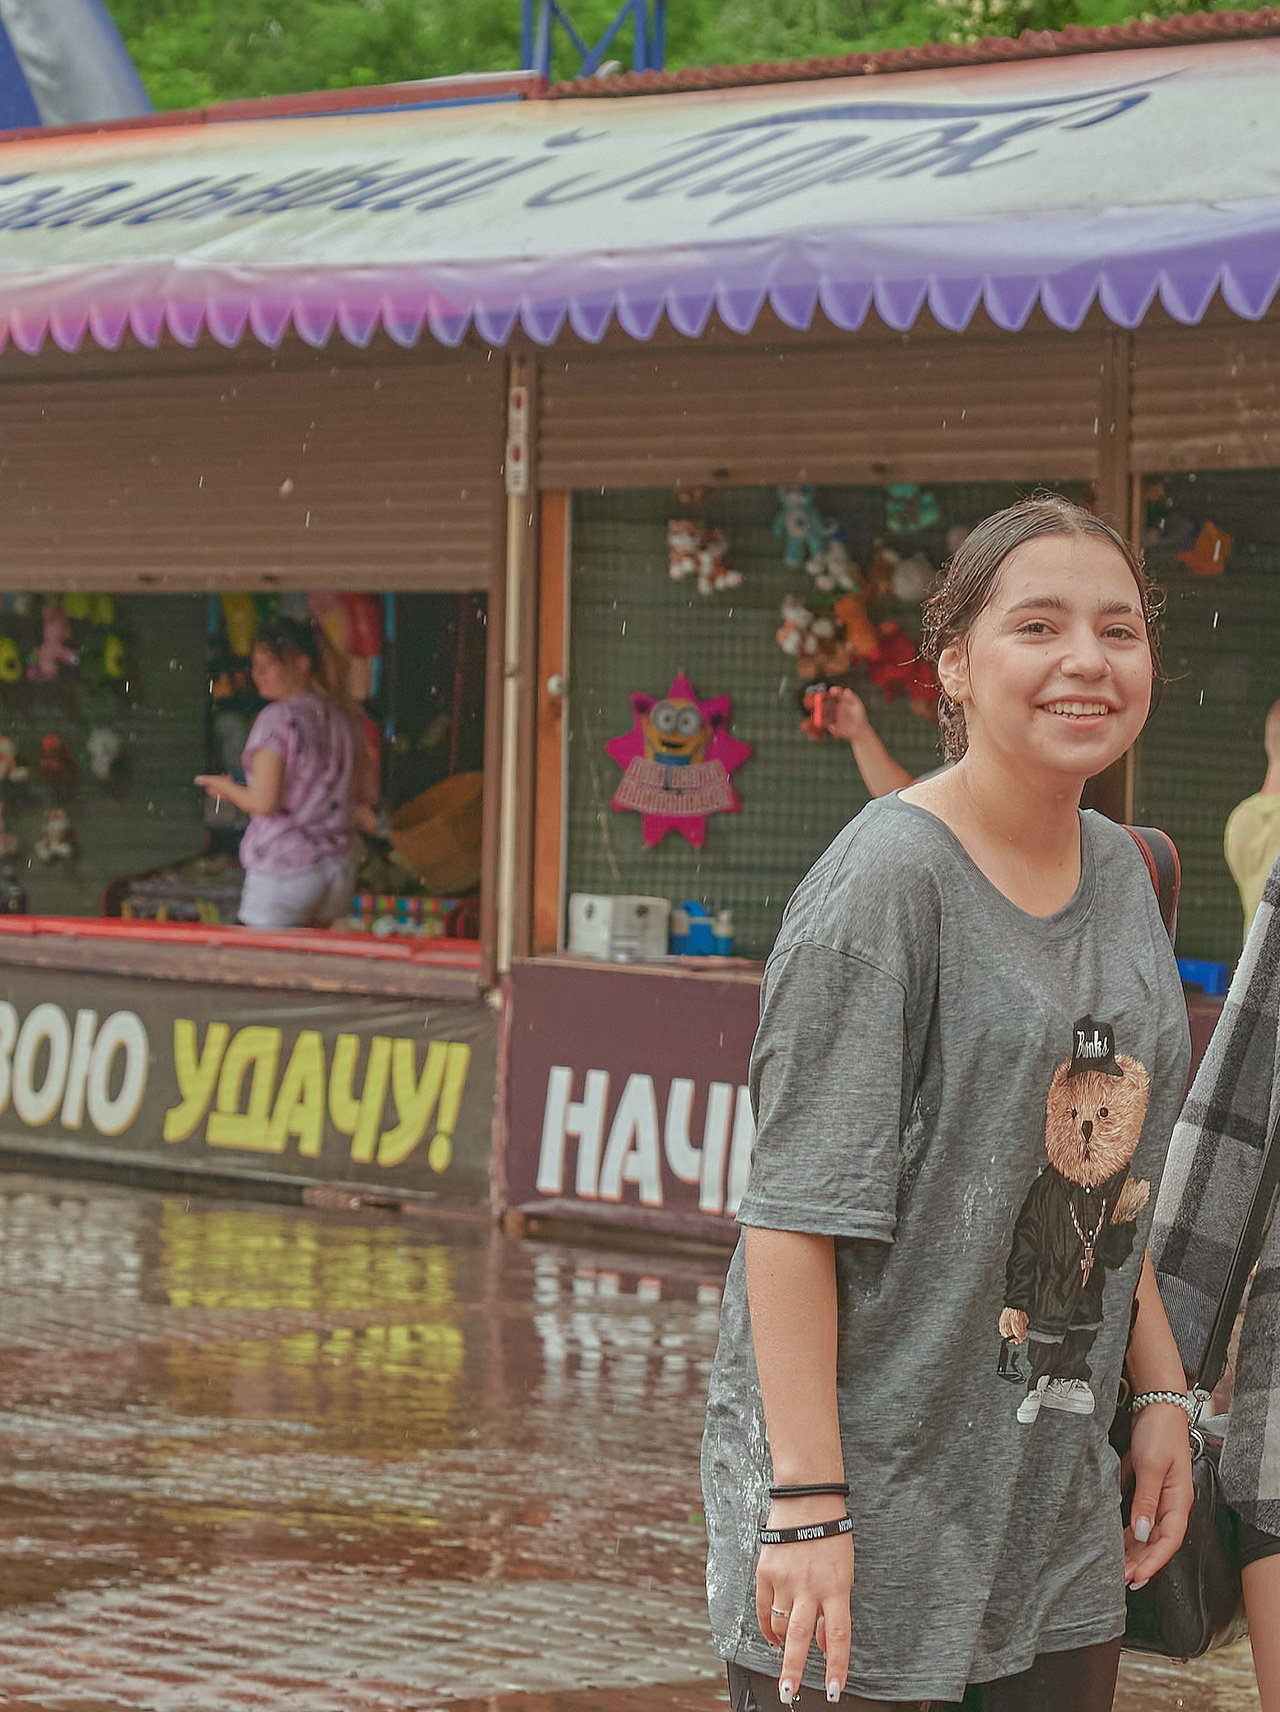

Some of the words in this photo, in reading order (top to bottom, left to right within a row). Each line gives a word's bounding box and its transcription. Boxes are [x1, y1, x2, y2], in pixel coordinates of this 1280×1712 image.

[519, 67, 1192, 228] Парк
[163, 1018, 472, 1173] УДАЧУ!
[797, 1526, 825, 1541] MACAN
